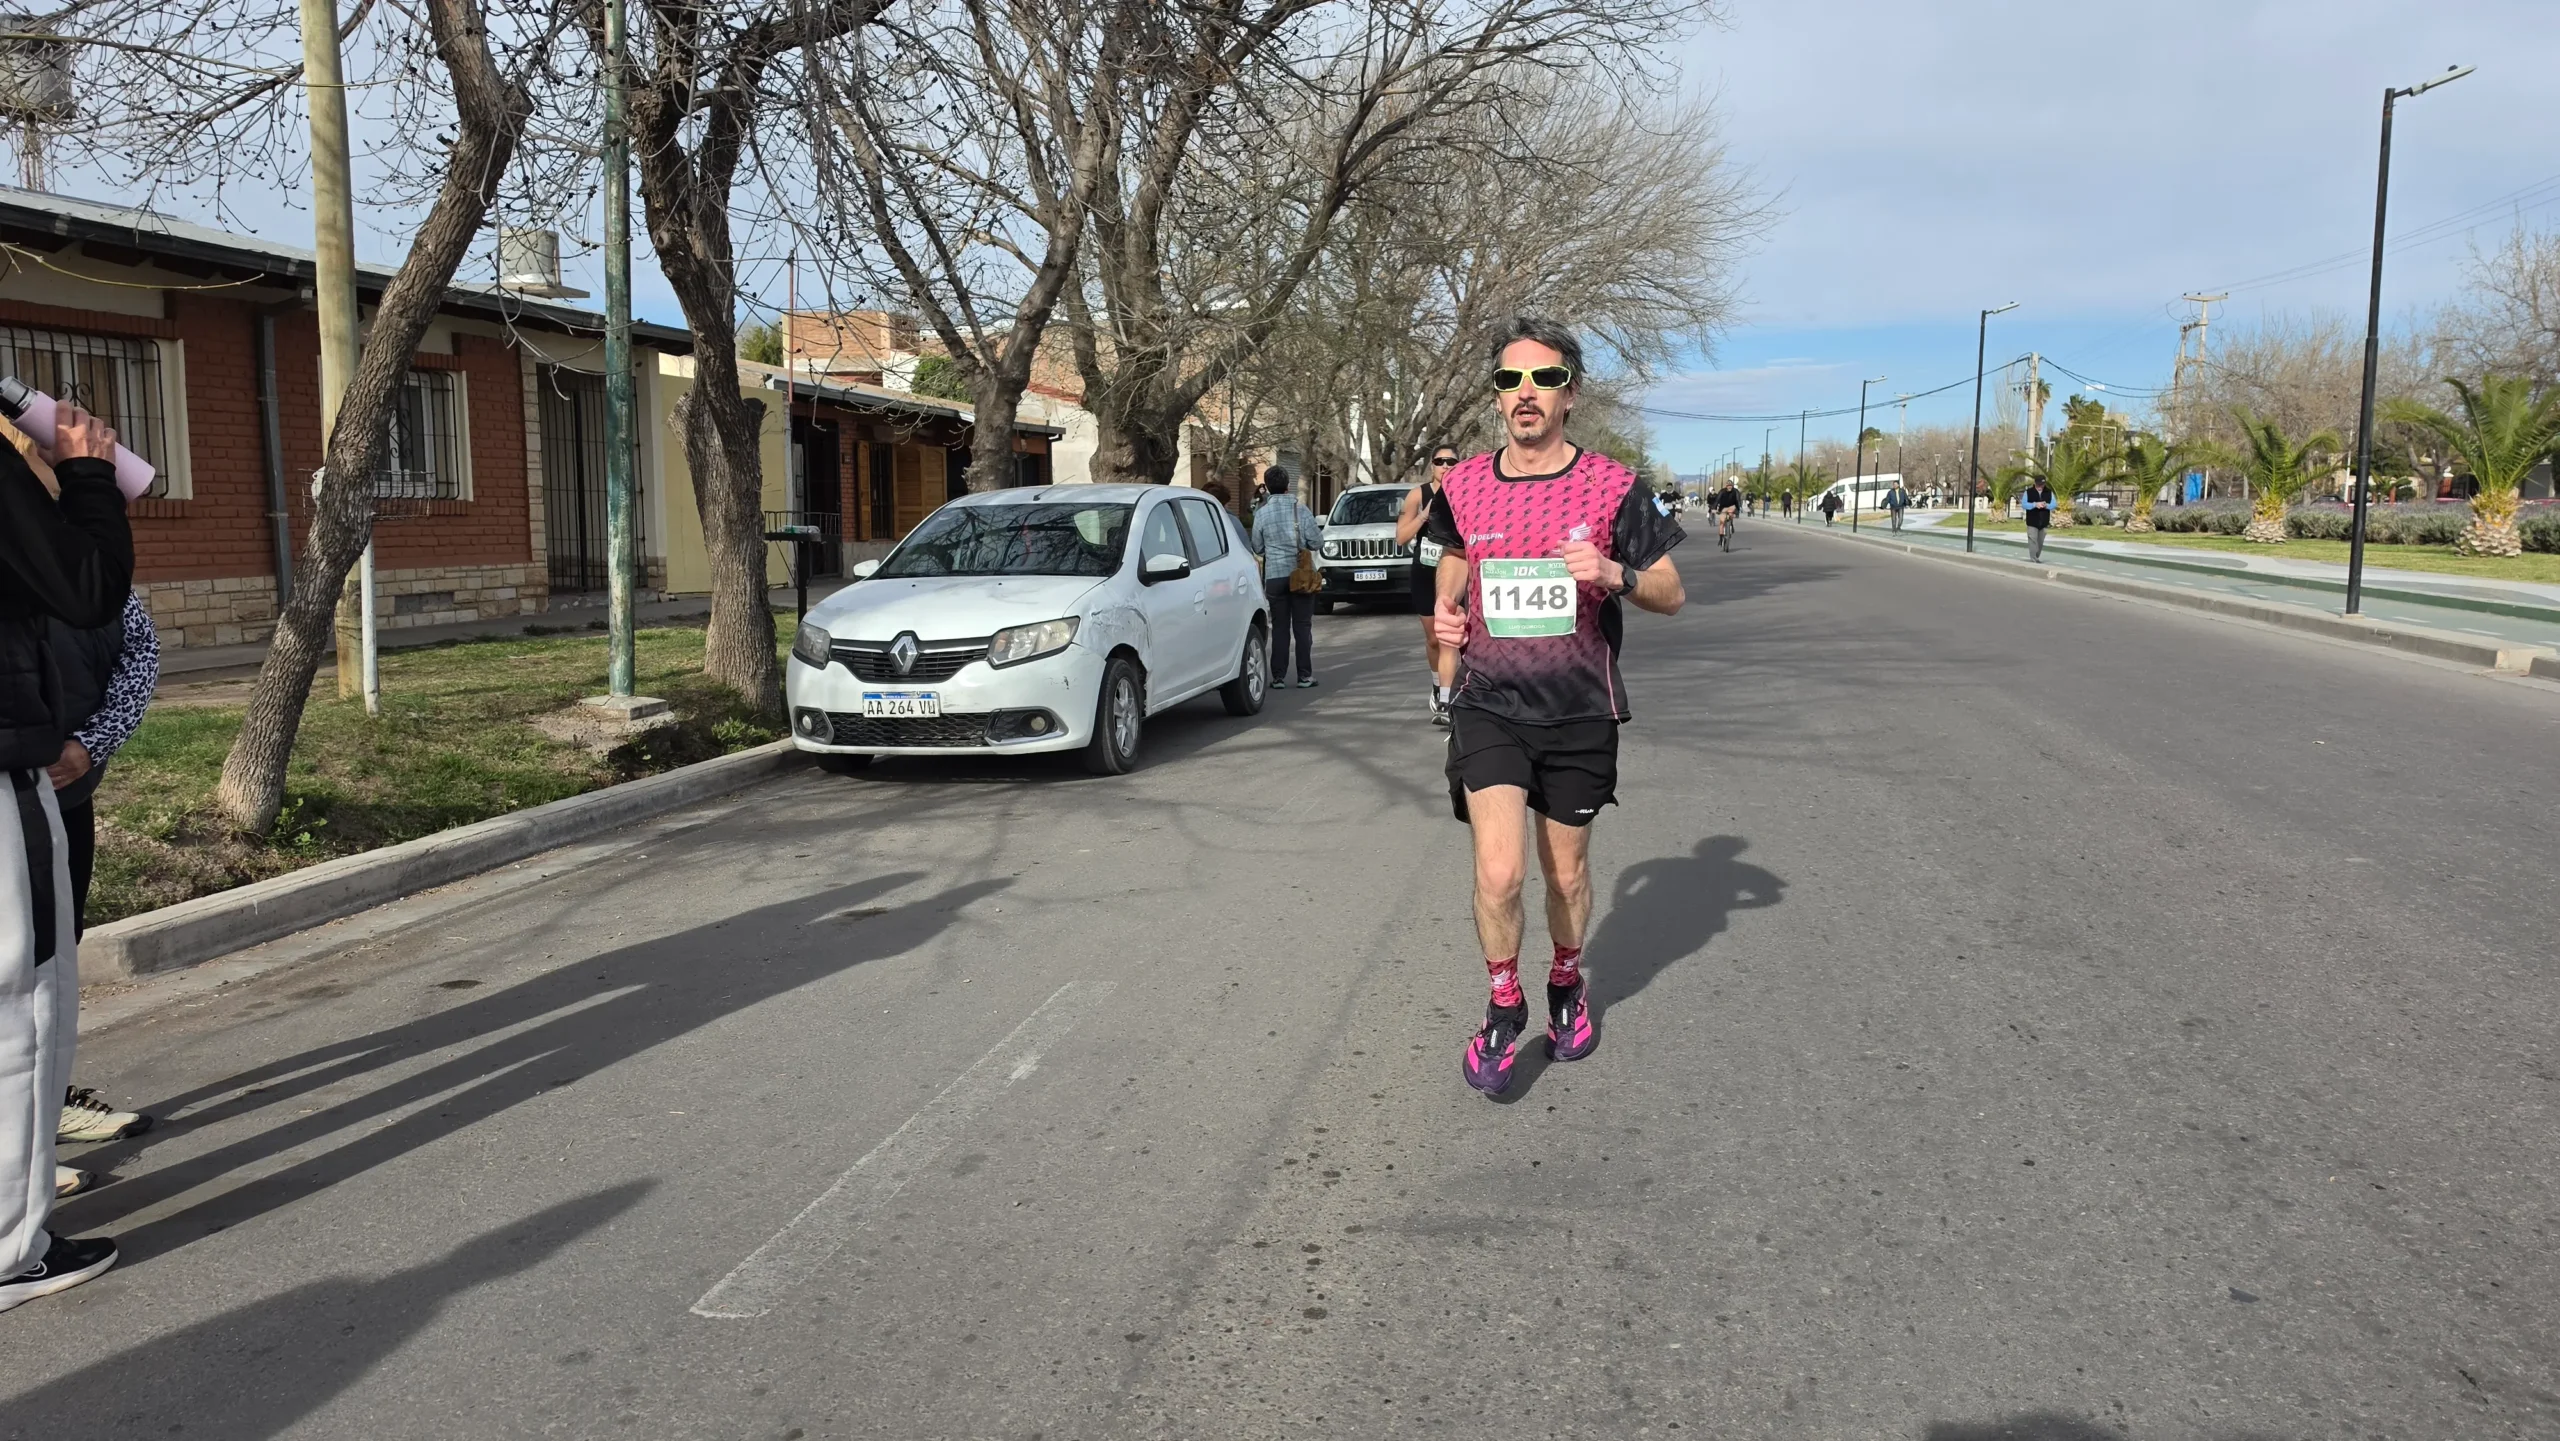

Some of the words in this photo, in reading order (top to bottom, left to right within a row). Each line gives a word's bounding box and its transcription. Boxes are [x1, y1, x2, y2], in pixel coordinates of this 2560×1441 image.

[1513, 566, 1540, 577] 10K
[1489, 584, 1568, 611] 1148
[867, 700, 884, 715] AA
[889, 700, 914, 715] 264
